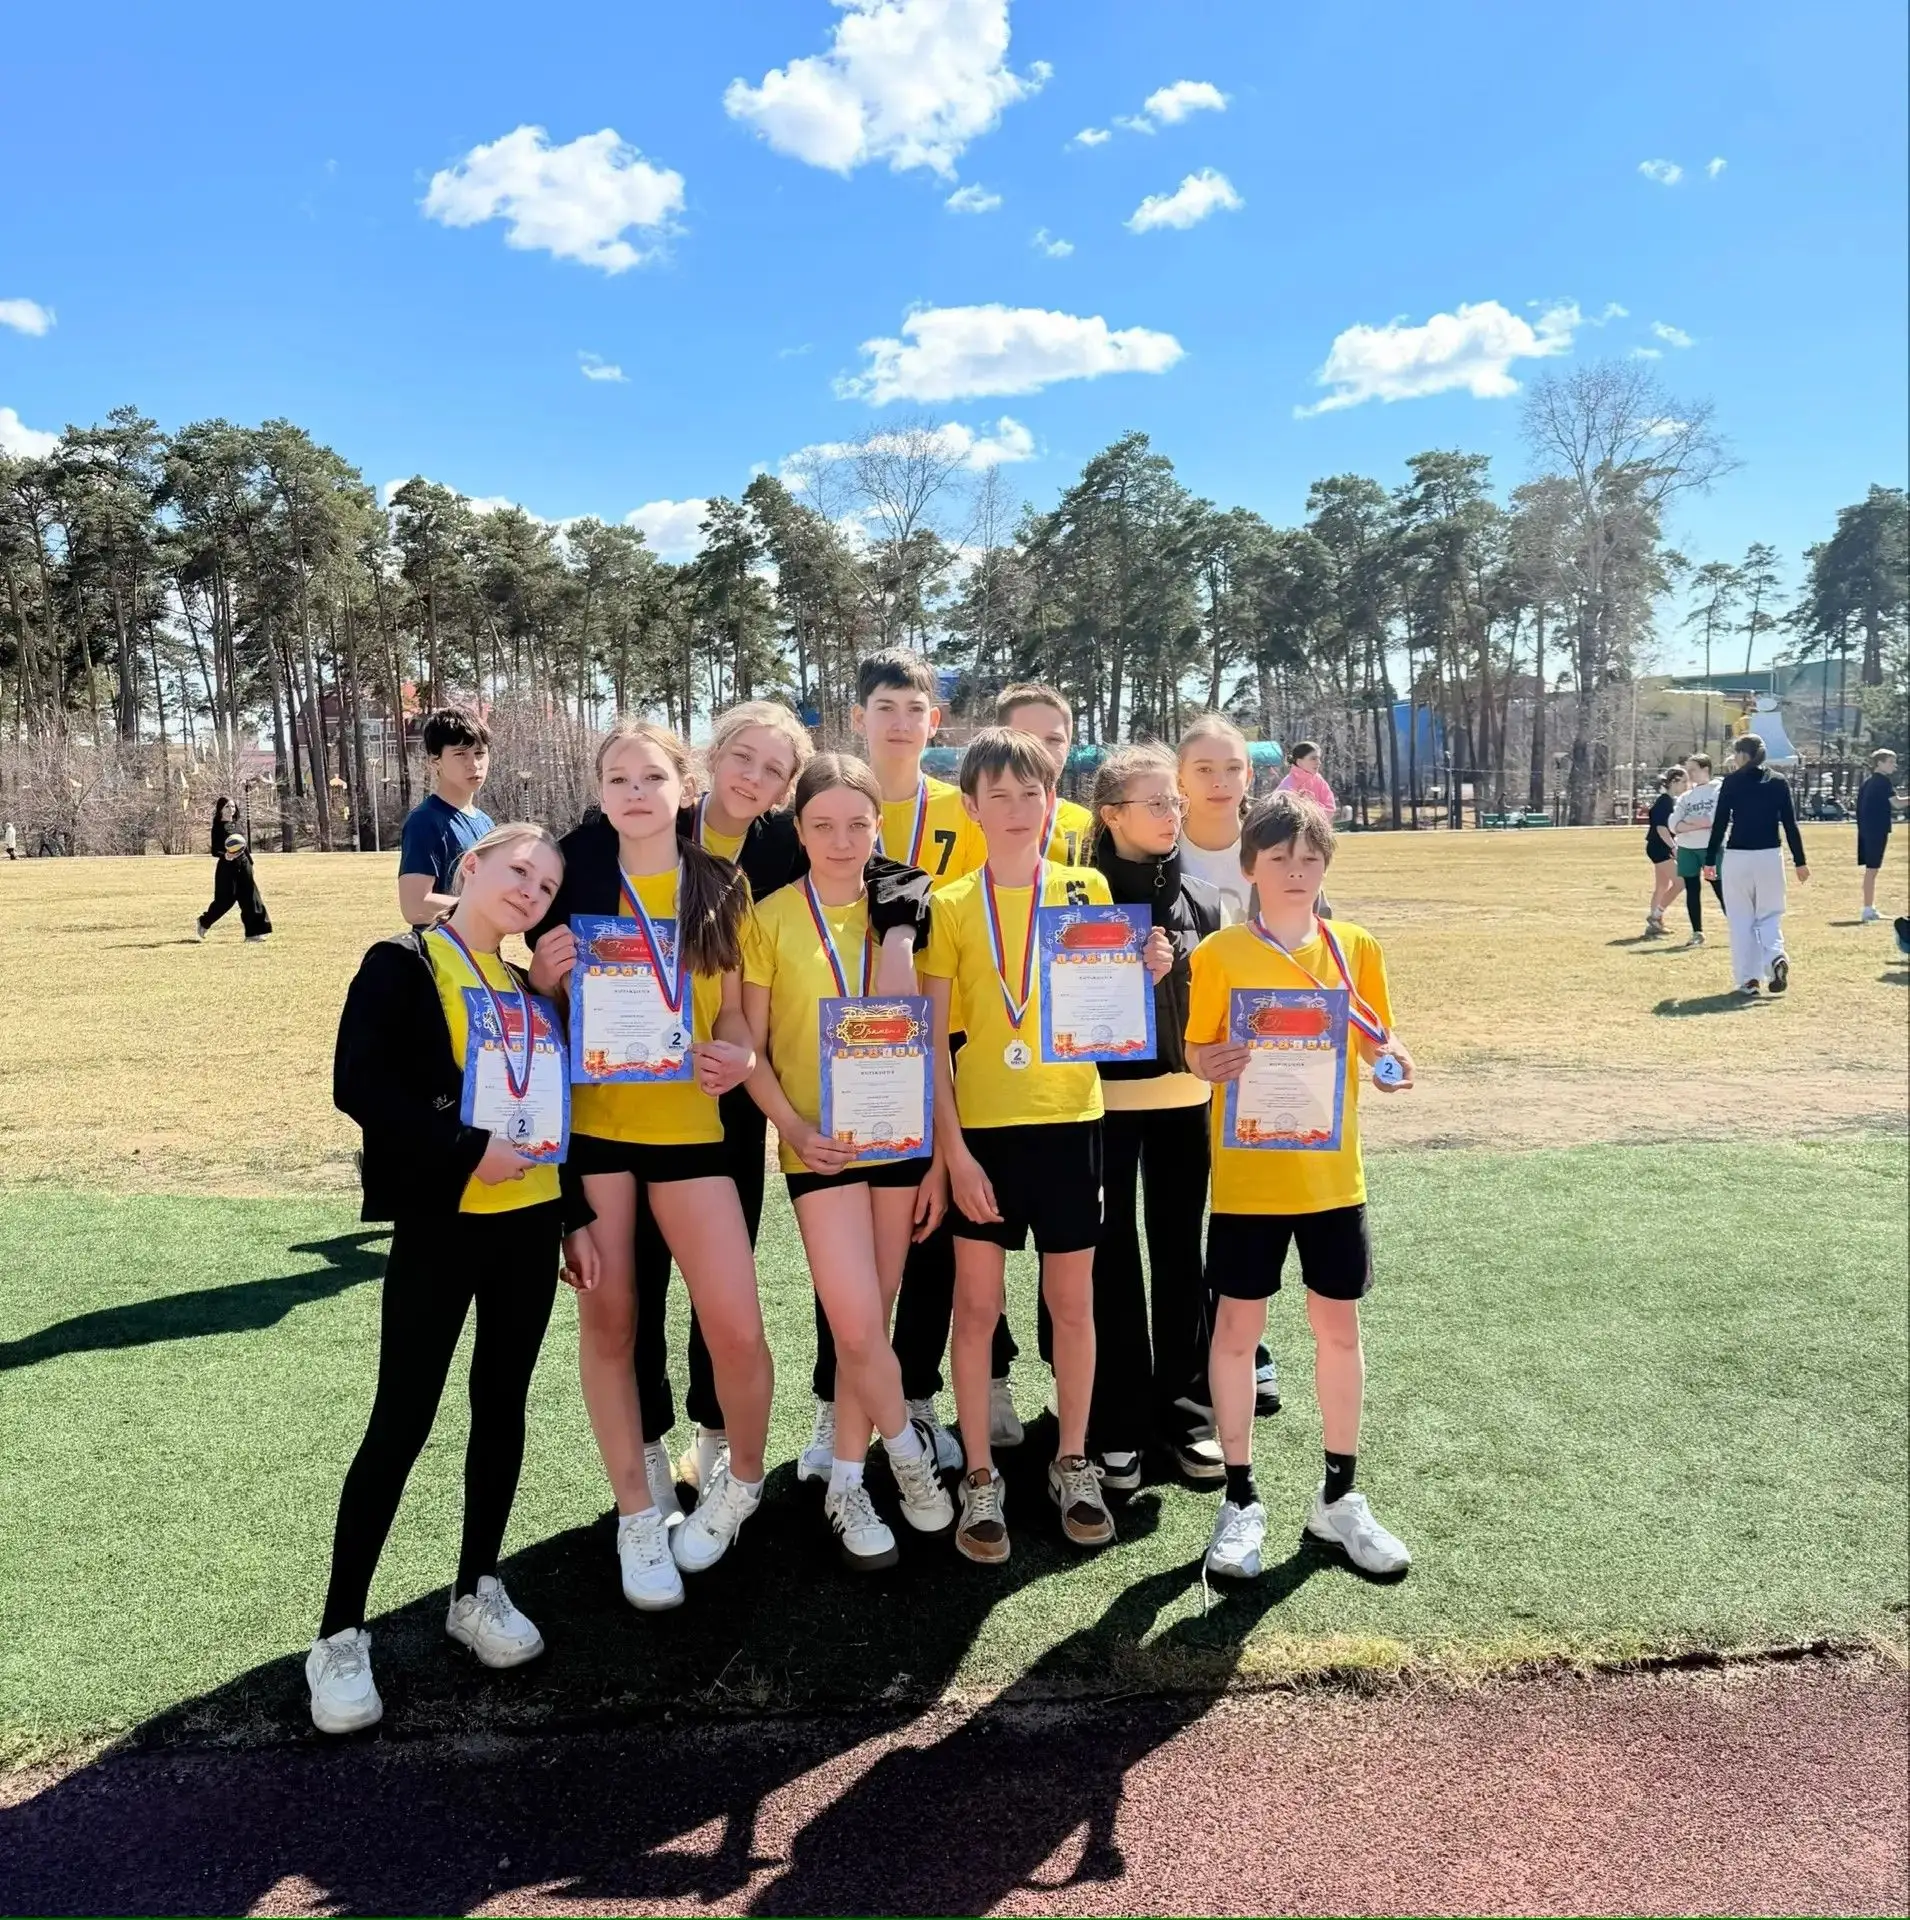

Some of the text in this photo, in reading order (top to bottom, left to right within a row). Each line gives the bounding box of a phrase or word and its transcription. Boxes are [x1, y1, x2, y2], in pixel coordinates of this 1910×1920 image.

[935, 830, 957, 875] 7
[672, 1032, 681, 1045] 2
[1013, 1048, 1022, 1060] 2
[1385, 1062, 1393, 1075] 2
[518, 1119, 526, 1133] 2
